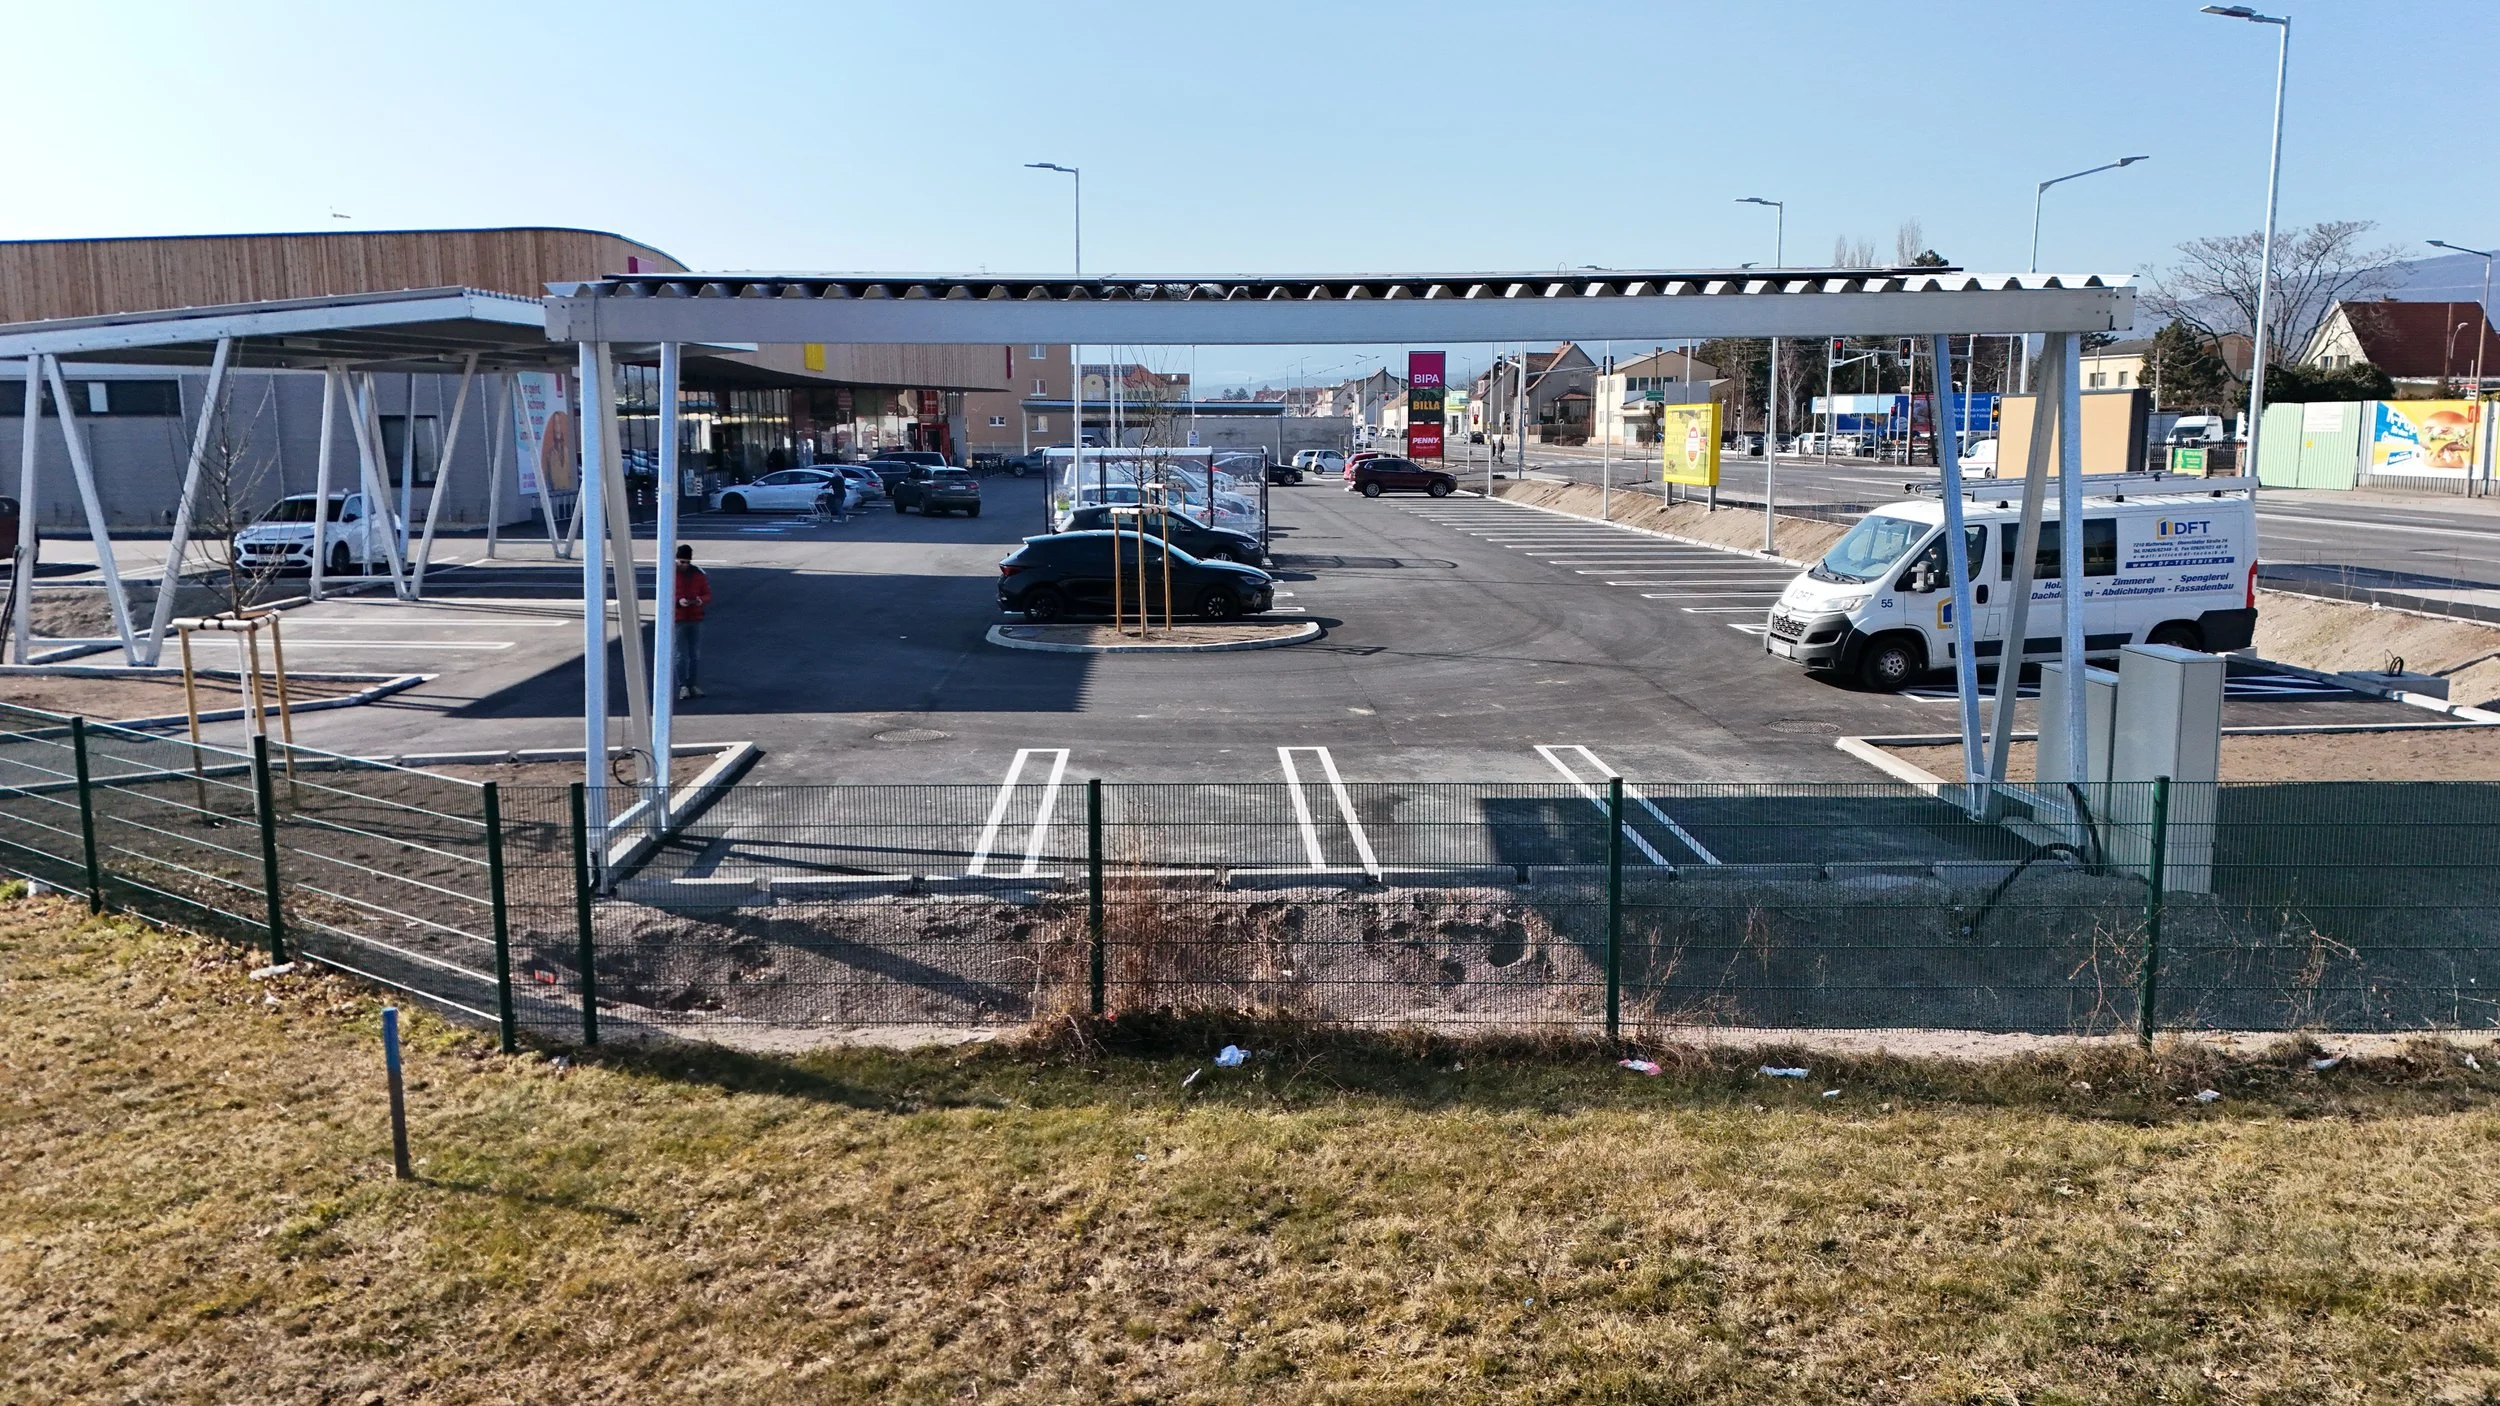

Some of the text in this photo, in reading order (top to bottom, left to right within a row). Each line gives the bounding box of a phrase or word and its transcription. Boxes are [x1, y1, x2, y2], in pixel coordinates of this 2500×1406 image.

[1414, 374, 1440, 384] BIPA
[1413, 400, 1440, 410] BILLA
[2175, 521, 2210, 535] DFT
[2112, 576, 2155, 586] Zimmerei
[2180, 572, 2229, 583] Spenglerei
[2102, 586, 2165, 597] Abdichtungen
[2174, 583, 2234, 593] Fassadenbau
[1881, 599, 1893, 609] 55
